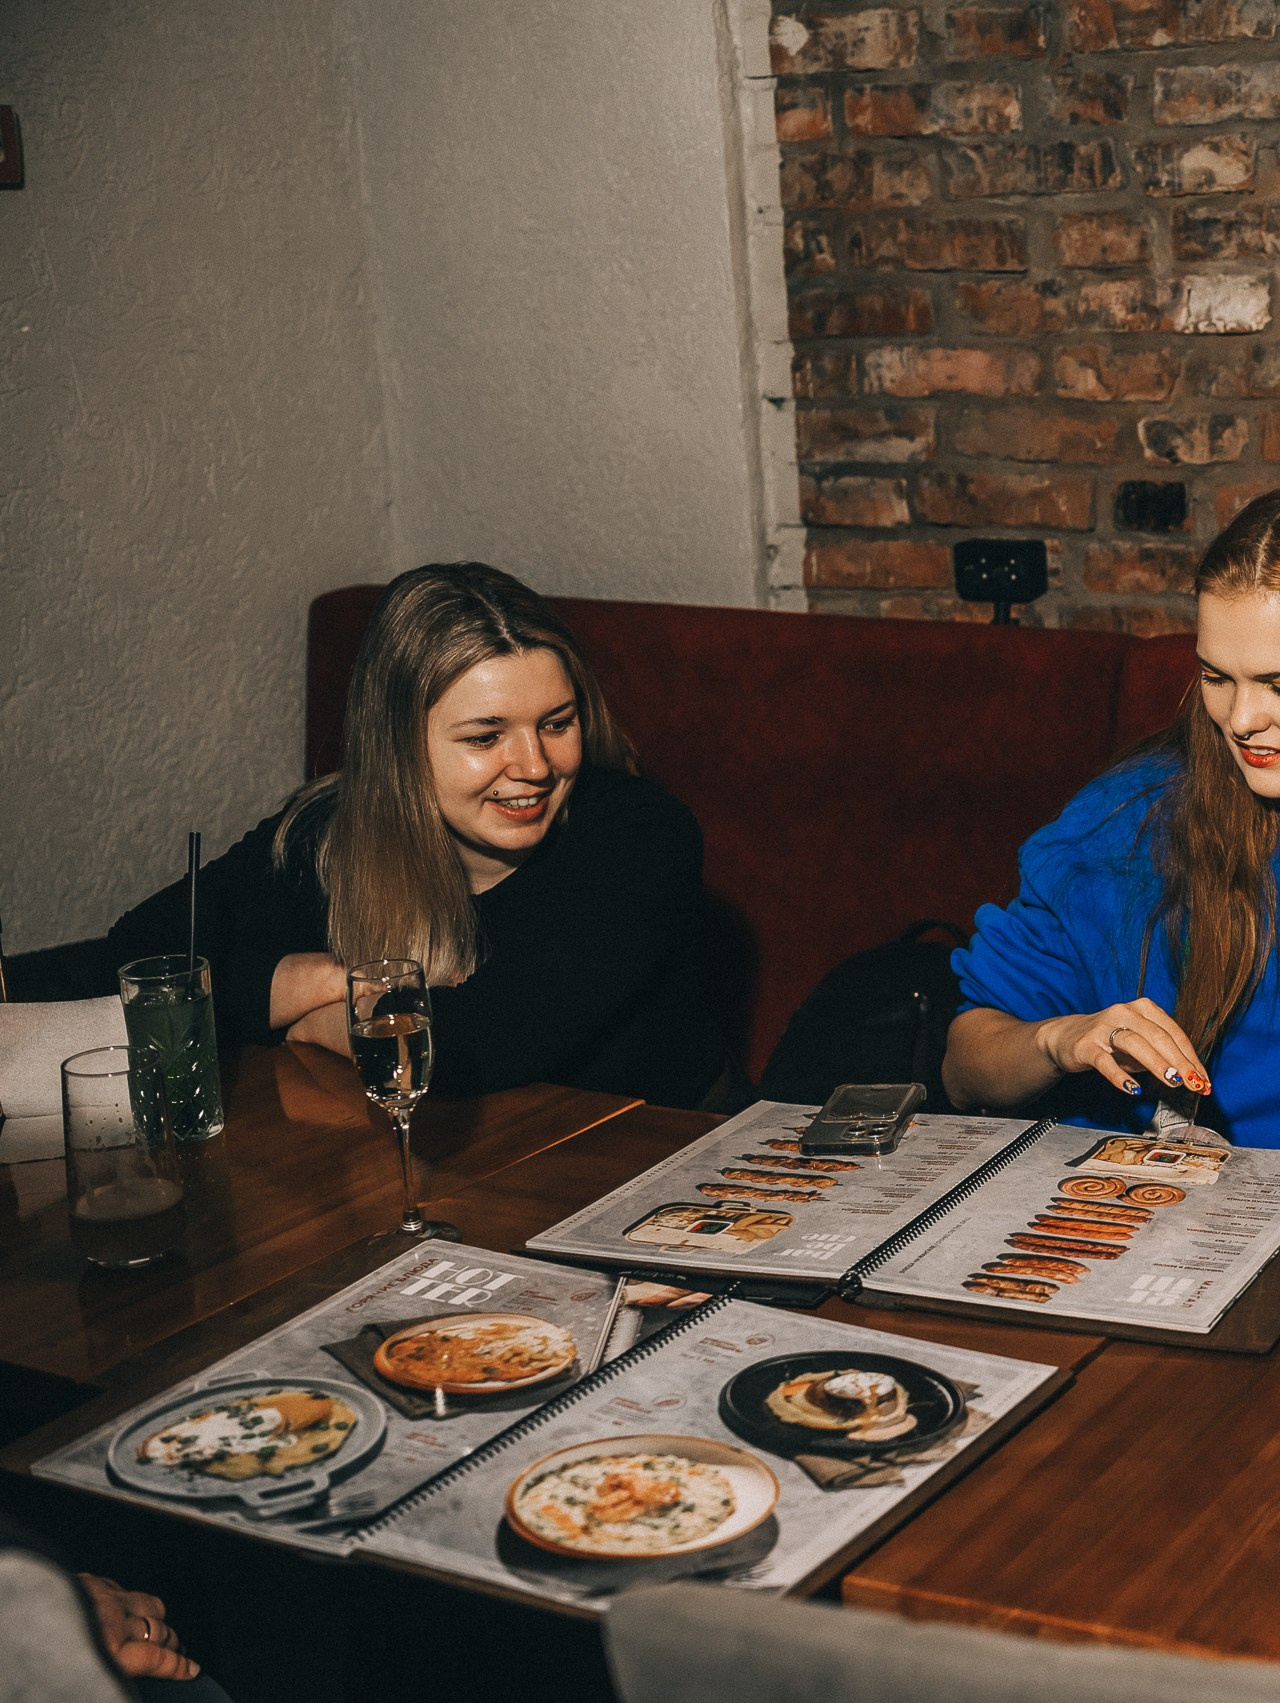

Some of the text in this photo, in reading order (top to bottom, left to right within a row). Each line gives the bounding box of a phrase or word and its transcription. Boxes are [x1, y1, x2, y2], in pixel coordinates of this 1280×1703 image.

[800, 1233, 857, 1242] cue
[804, 1241, 847, 1252] be
[773, 1248, 835, 1260] bar
[344, 1257, 440, 1313] ГОРЯЧИЕ БЛЮДА
[422, 1260, 525, 1291] HOT
[400, 1277, 492, 1308] TER
[1182, 1279, 1214, 1309] МАНГАЛ
